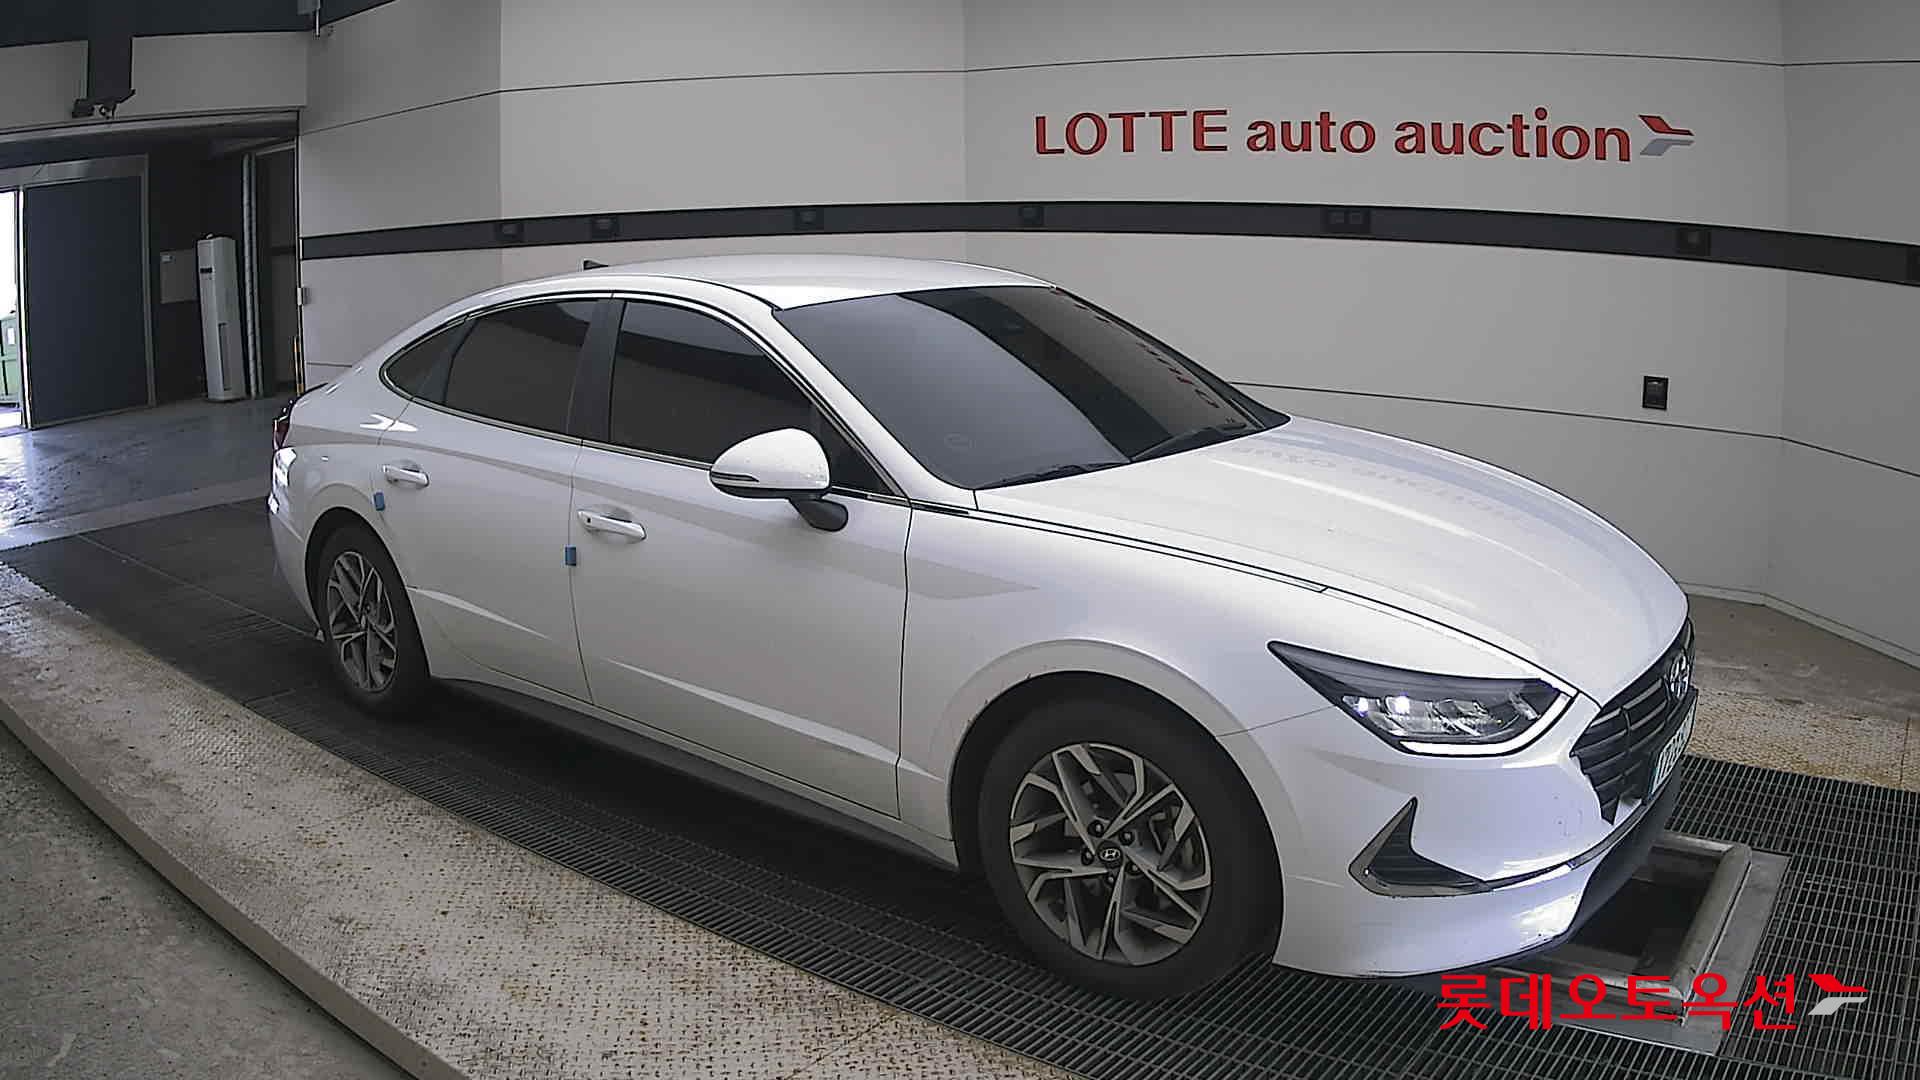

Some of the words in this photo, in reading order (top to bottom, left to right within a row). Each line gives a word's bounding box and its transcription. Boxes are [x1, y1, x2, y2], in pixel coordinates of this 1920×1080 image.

[1036, 110, 1228, 156] LOTTE
[1247, 112, 1376, 153] auto
[1395, 108, 1630, 162] auction
